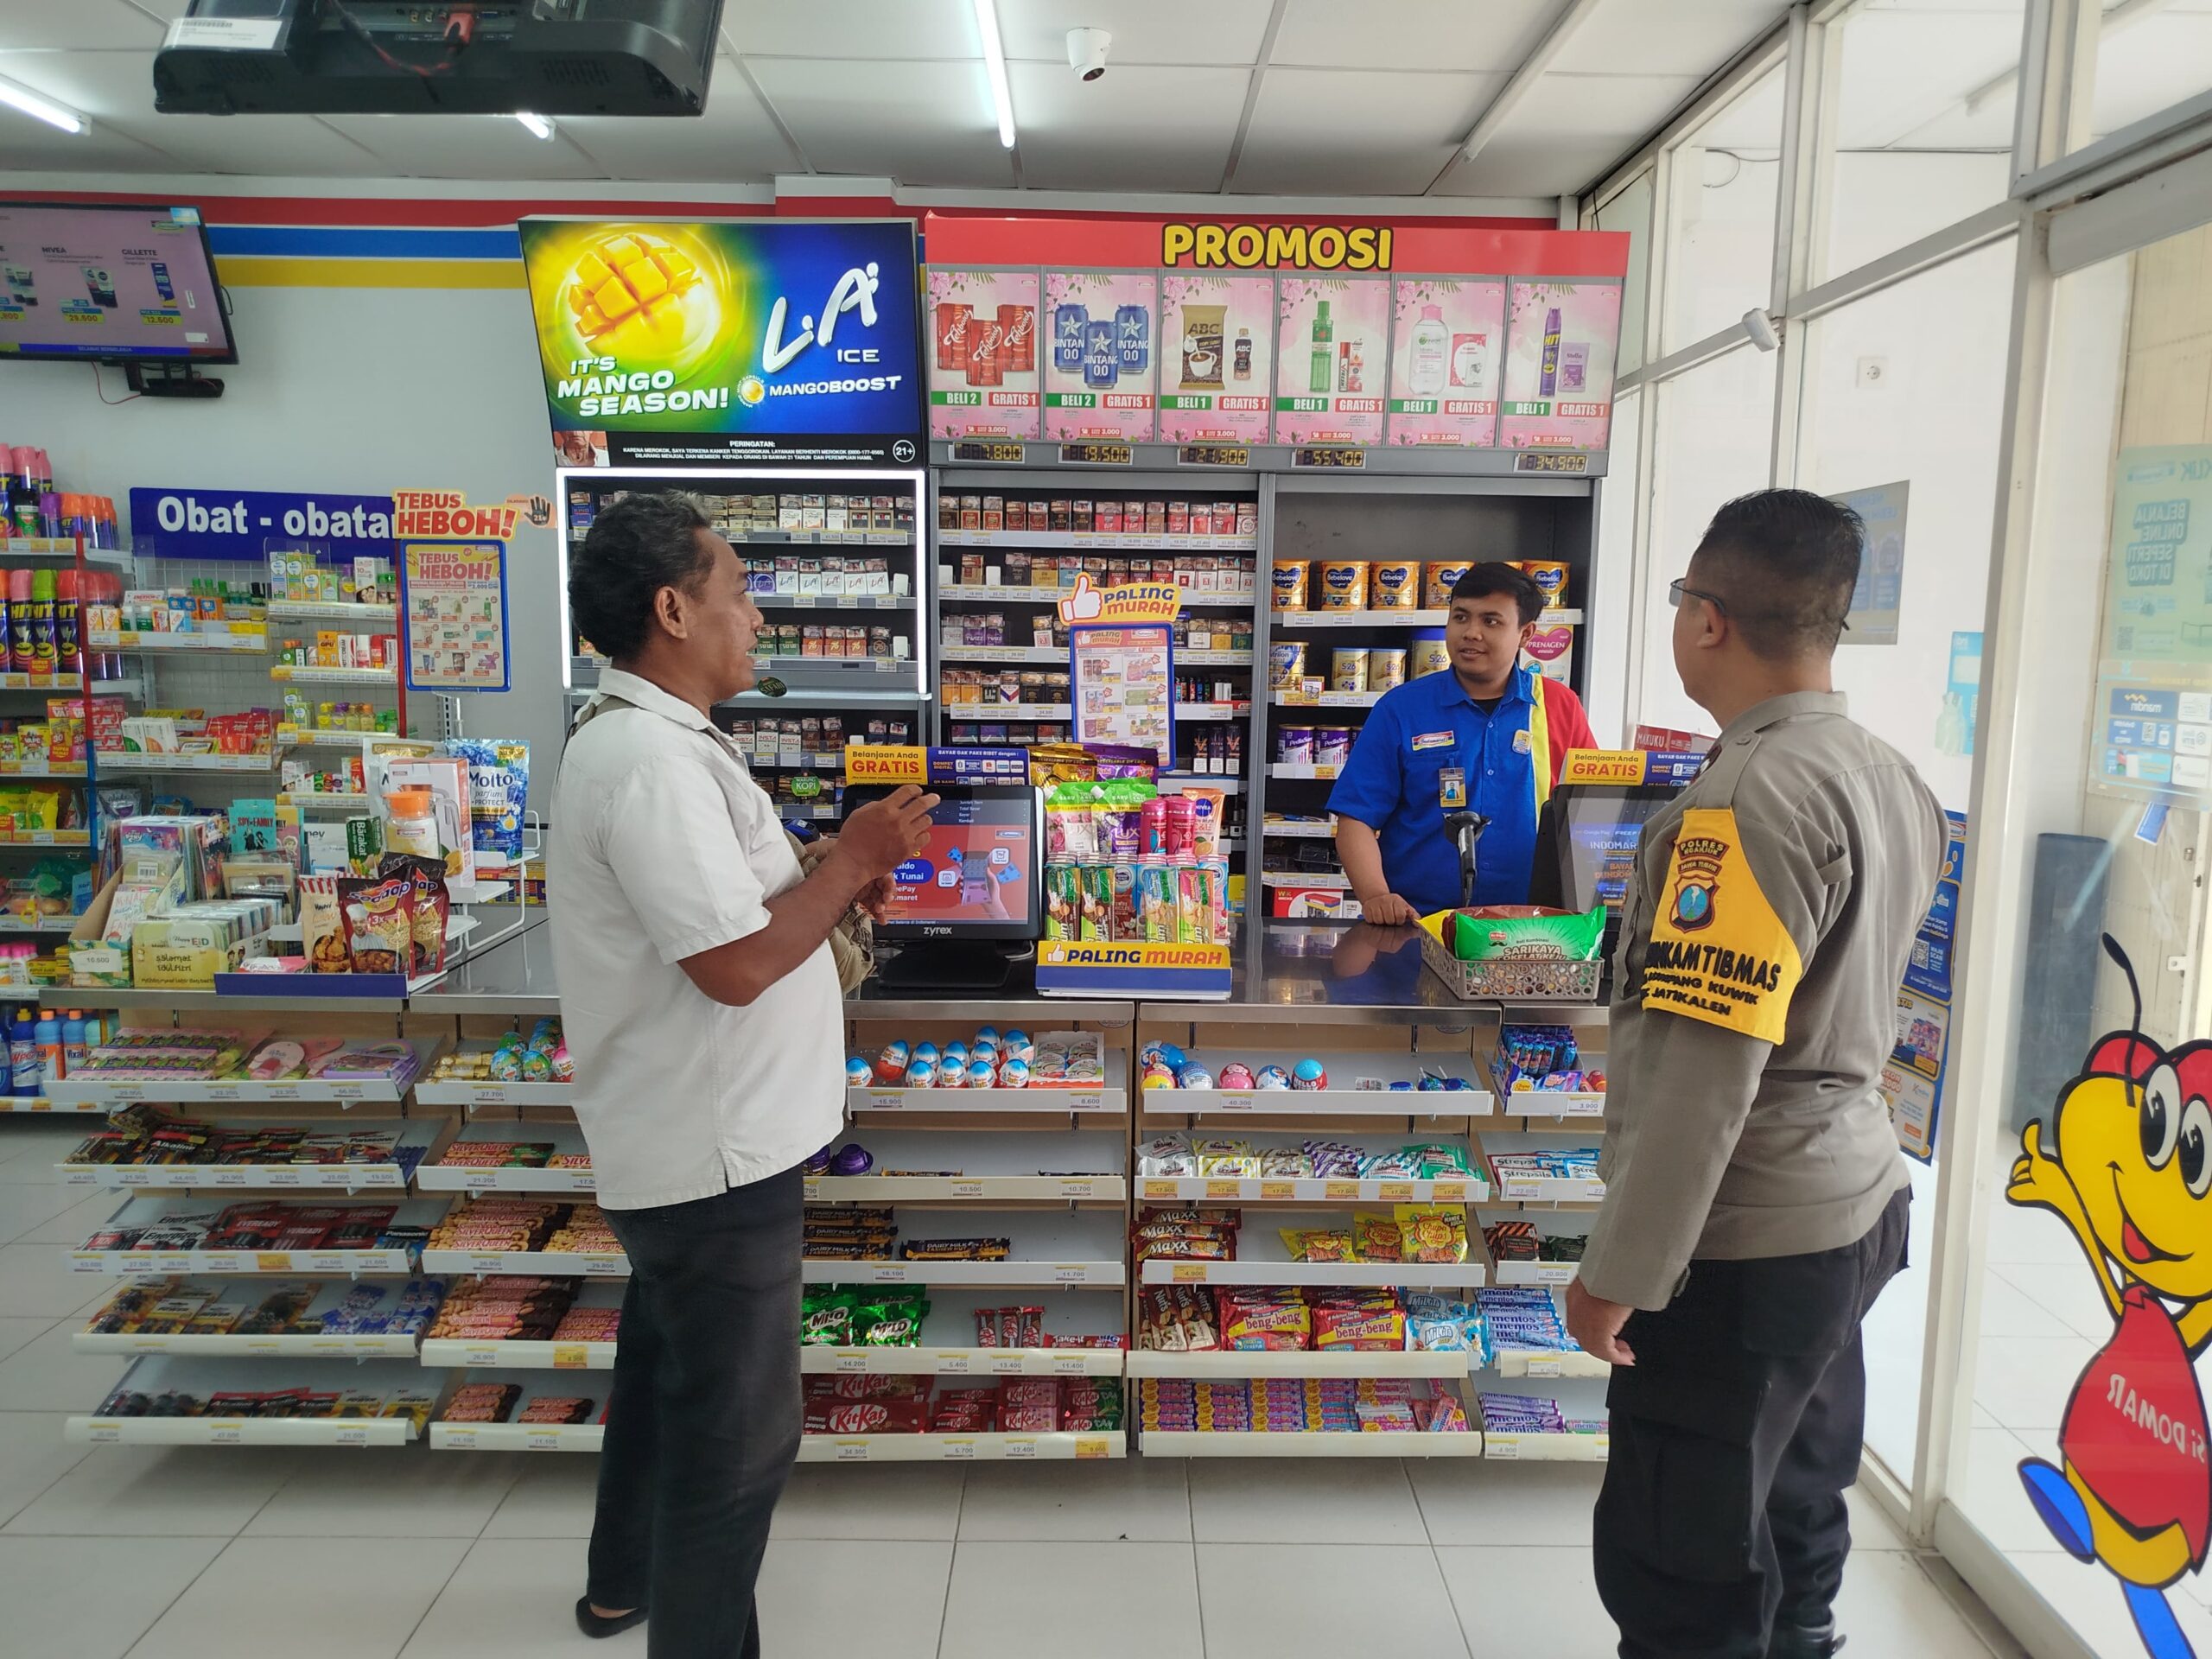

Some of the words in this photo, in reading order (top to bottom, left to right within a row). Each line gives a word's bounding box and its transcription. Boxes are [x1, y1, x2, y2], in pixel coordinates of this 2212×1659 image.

[1163, 224, 1393, 270] PROMOSI
[1188, 323, 1220, 334] ABC
[837, 349, 880, 363] ICE
[570, 356, 617, 376] IT'S
[557, 370, 675, 398] MANGO
[770, 376, 902, 397] MANGOBOOST
[579, 388, 730, 416] SEASON!
[946, 394, 969, 404] BELI
[969, 394, 977, 404] 2
[992, 396, 1027, 406] GRATIS
[1029, 396, 1036, 406] 1
[1061, 396, 1083, 406] BELI
[1084, 396, 1091, 406] 2
[1107, 397, 1141, 408] GRATIS
[1144, 397, 1151, 408] 1
[1177, 397, 1198, 408] BELI
[1200, 397, 1206, 408] 1
[1224, 398, 1258, 409] GRATIS
[1260, 398, 1266, 409] 1
[1294, 399, 1315, 410] BELI
[1318, 399, 1323, 410] 1
[1339, 400, 1374, 411] GRATIS
[1377, 400, 1382, 411] 1
[1403, 402, 1425, 413] BELI
[1427, 402, 1433, 413] 1
[1448, 403, 1483, 414] GRATIS
[1485, 403, 1491, 414] 1
[1516, 404, 1538, 415] BELI
[1540, 404, 1545, 415] 1
[1560, 404, 1596, 416] GRATIS
[1599, 404, 1605, 416] 1
[896, 447, 913, 456] 21+
[397, 493, 461, 509] TEBUS
[157, 496, 249, 534] Obat
[397, 508, 517, 537] HEBOH!
[419, 553, 459, 563] TEBUS
[419, 563, 493, 581] HEBOH!
[1104, 588, 1175, 603] PALING
[1107, 601, 1175, 615] MURAH
[853, 751, 894, 760] Belanjaan
[1575, 754, 1616, 764] Belanjaan
[852, 760, 920, 773] GRATIS
[1573, 763, 1638, 777] GRATIS
[469, 772, 514, 787] Molto
[797, 781, 816, 790] KOPI
[1681, 840, 1724, 851] POLRES
[924, 926, 952, 936] zyrex
[1503, 944, 1561, 956] SARIKAYA
[1066, 950, 1141, 963] PALING
[1142, 951, 1222, 965] MURAH
[1503, 1170, 1552, 1179] Strepsils
[1244, 1312, 1302, 1331] beng-beng
[1335, 1321, 1393, 1338] beng-beng
[832, 1405, 887, 1432] KitKat
